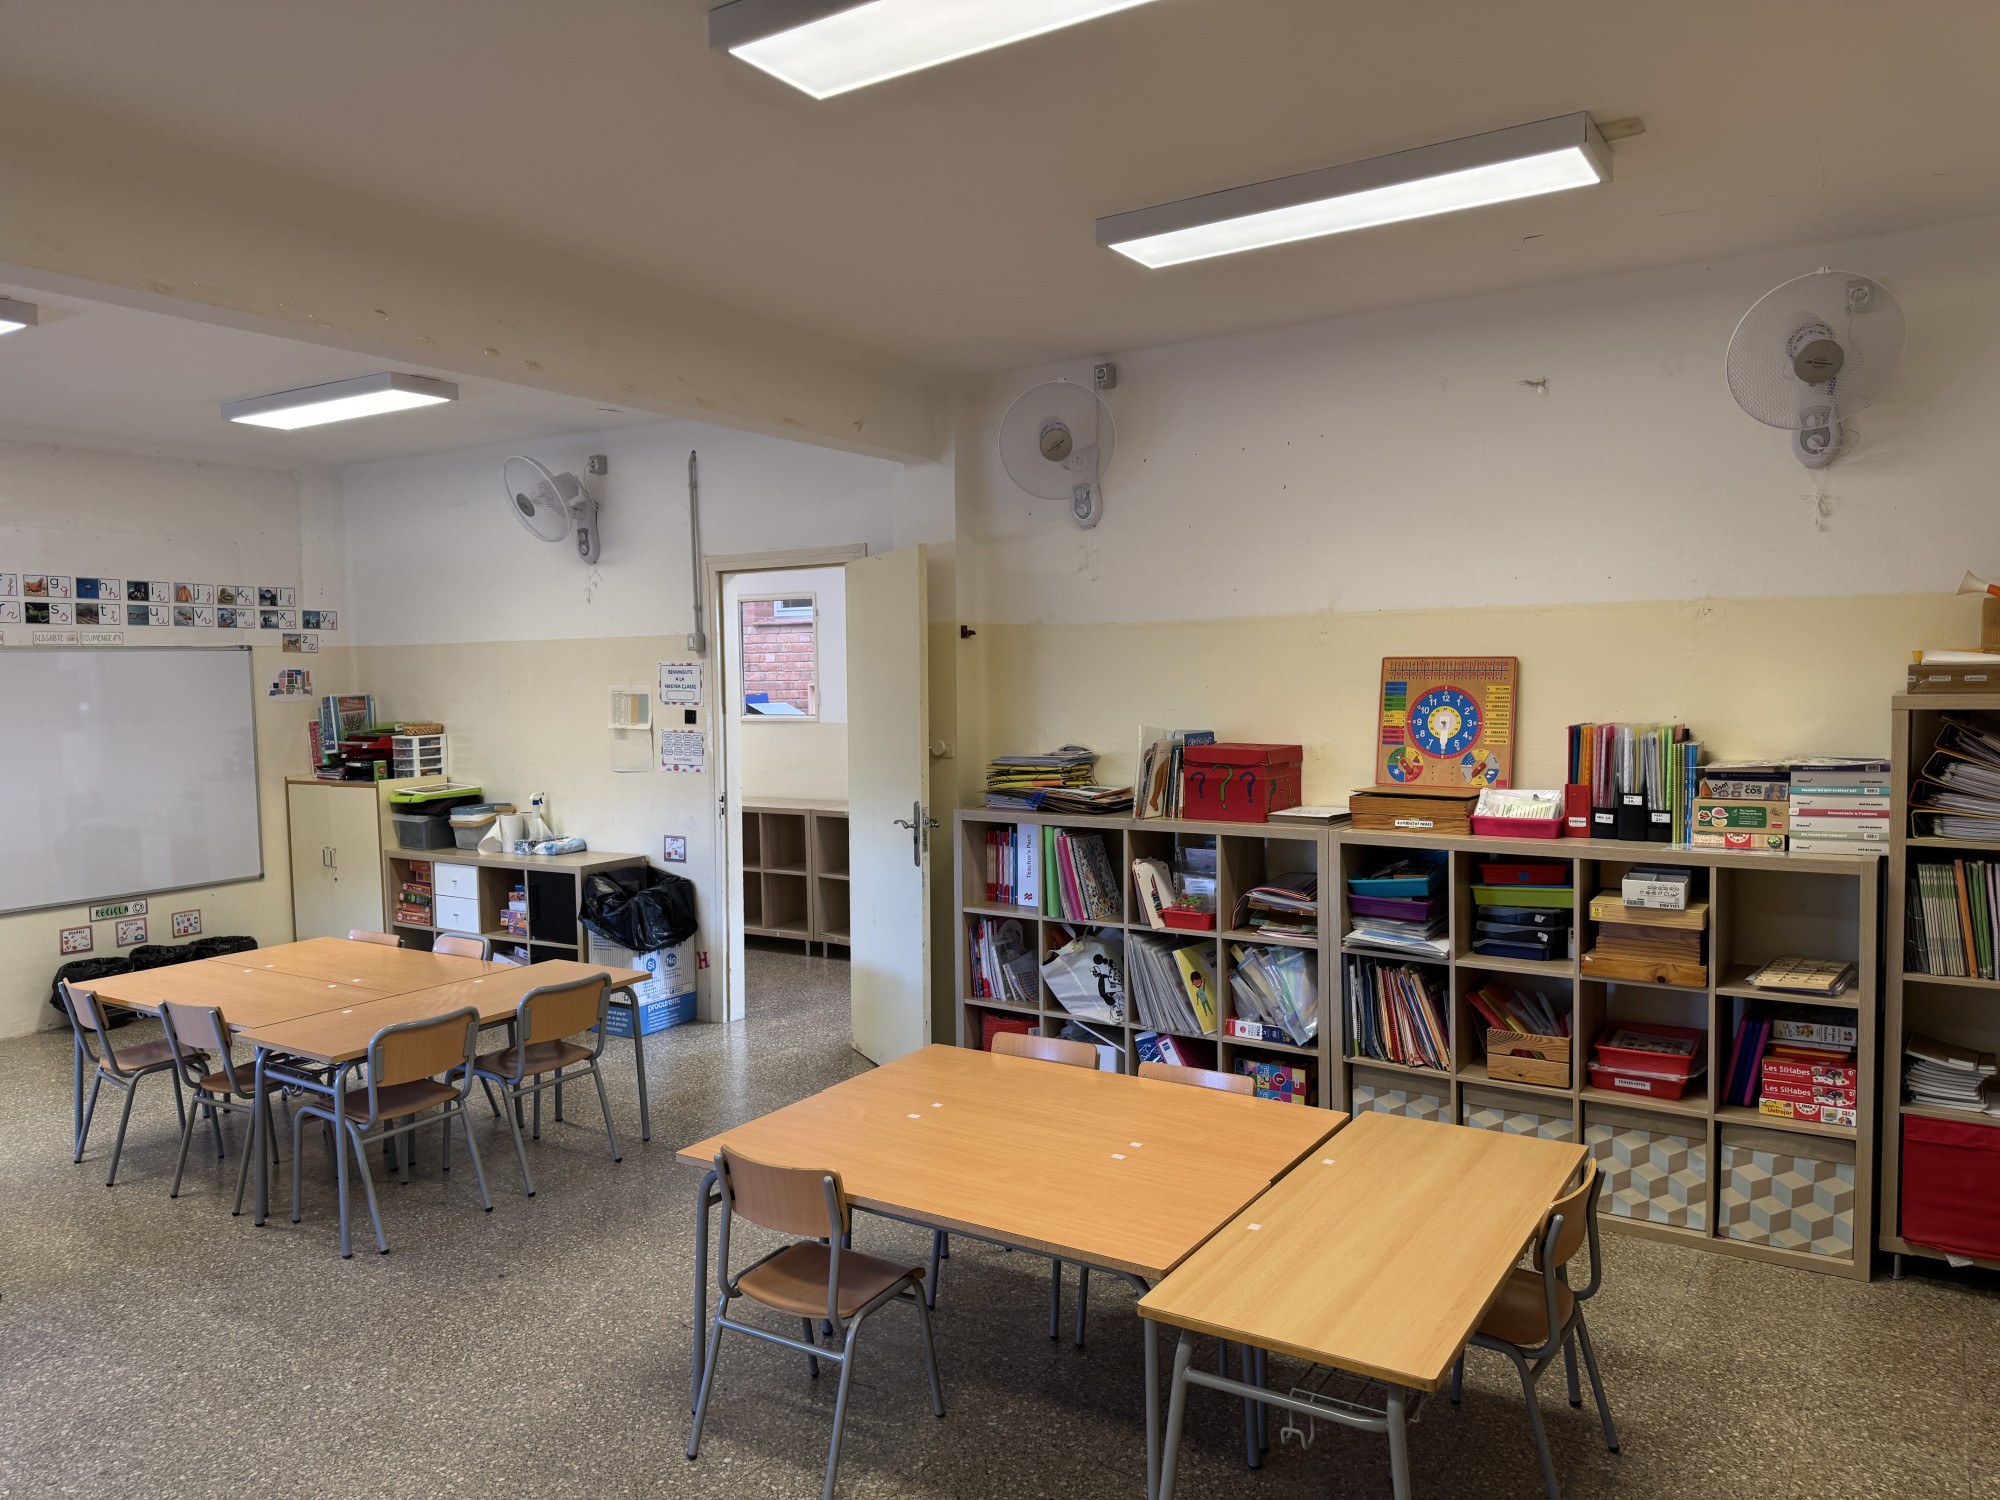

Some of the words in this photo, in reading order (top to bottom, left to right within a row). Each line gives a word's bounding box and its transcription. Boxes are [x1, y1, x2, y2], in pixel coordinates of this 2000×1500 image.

[1712, 782, 1728, 792] Diset
[696, 951, 710, 970] H
[647, 997, 680, 1013] procurem:
